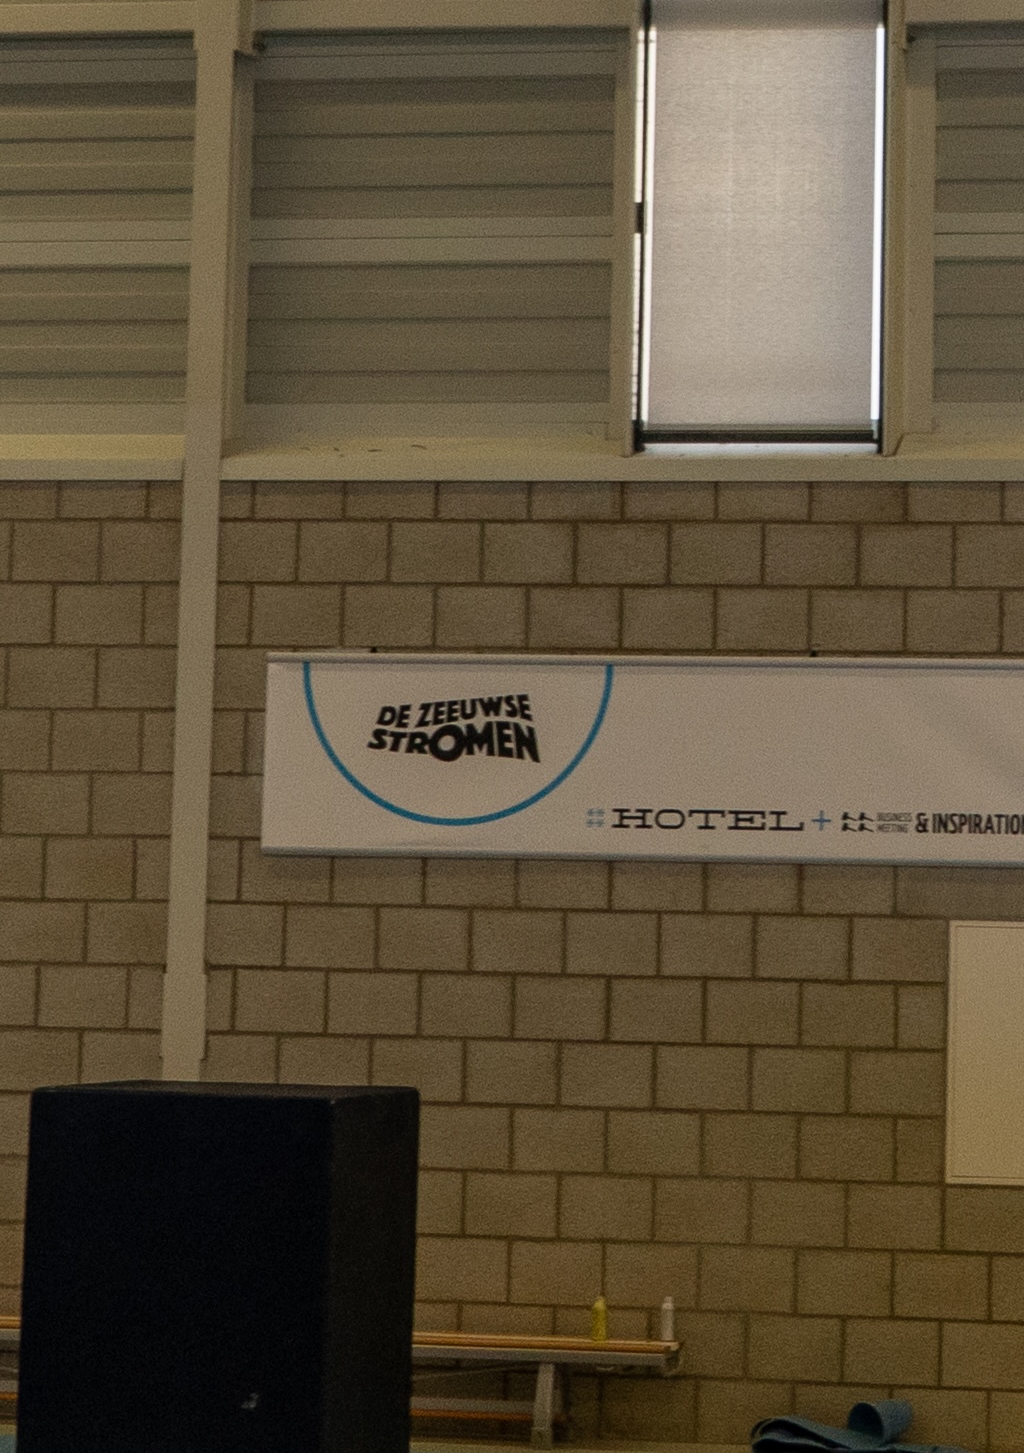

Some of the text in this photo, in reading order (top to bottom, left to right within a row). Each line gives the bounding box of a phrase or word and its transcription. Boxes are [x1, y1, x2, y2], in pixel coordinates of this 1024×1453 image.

[376, 694, 533, 728] DE ZEEUWSE
[367, 721, 541, 763] STROMEN
[612, 808, 804, 831] HOTEL
[915, 812, 929, 834] &
